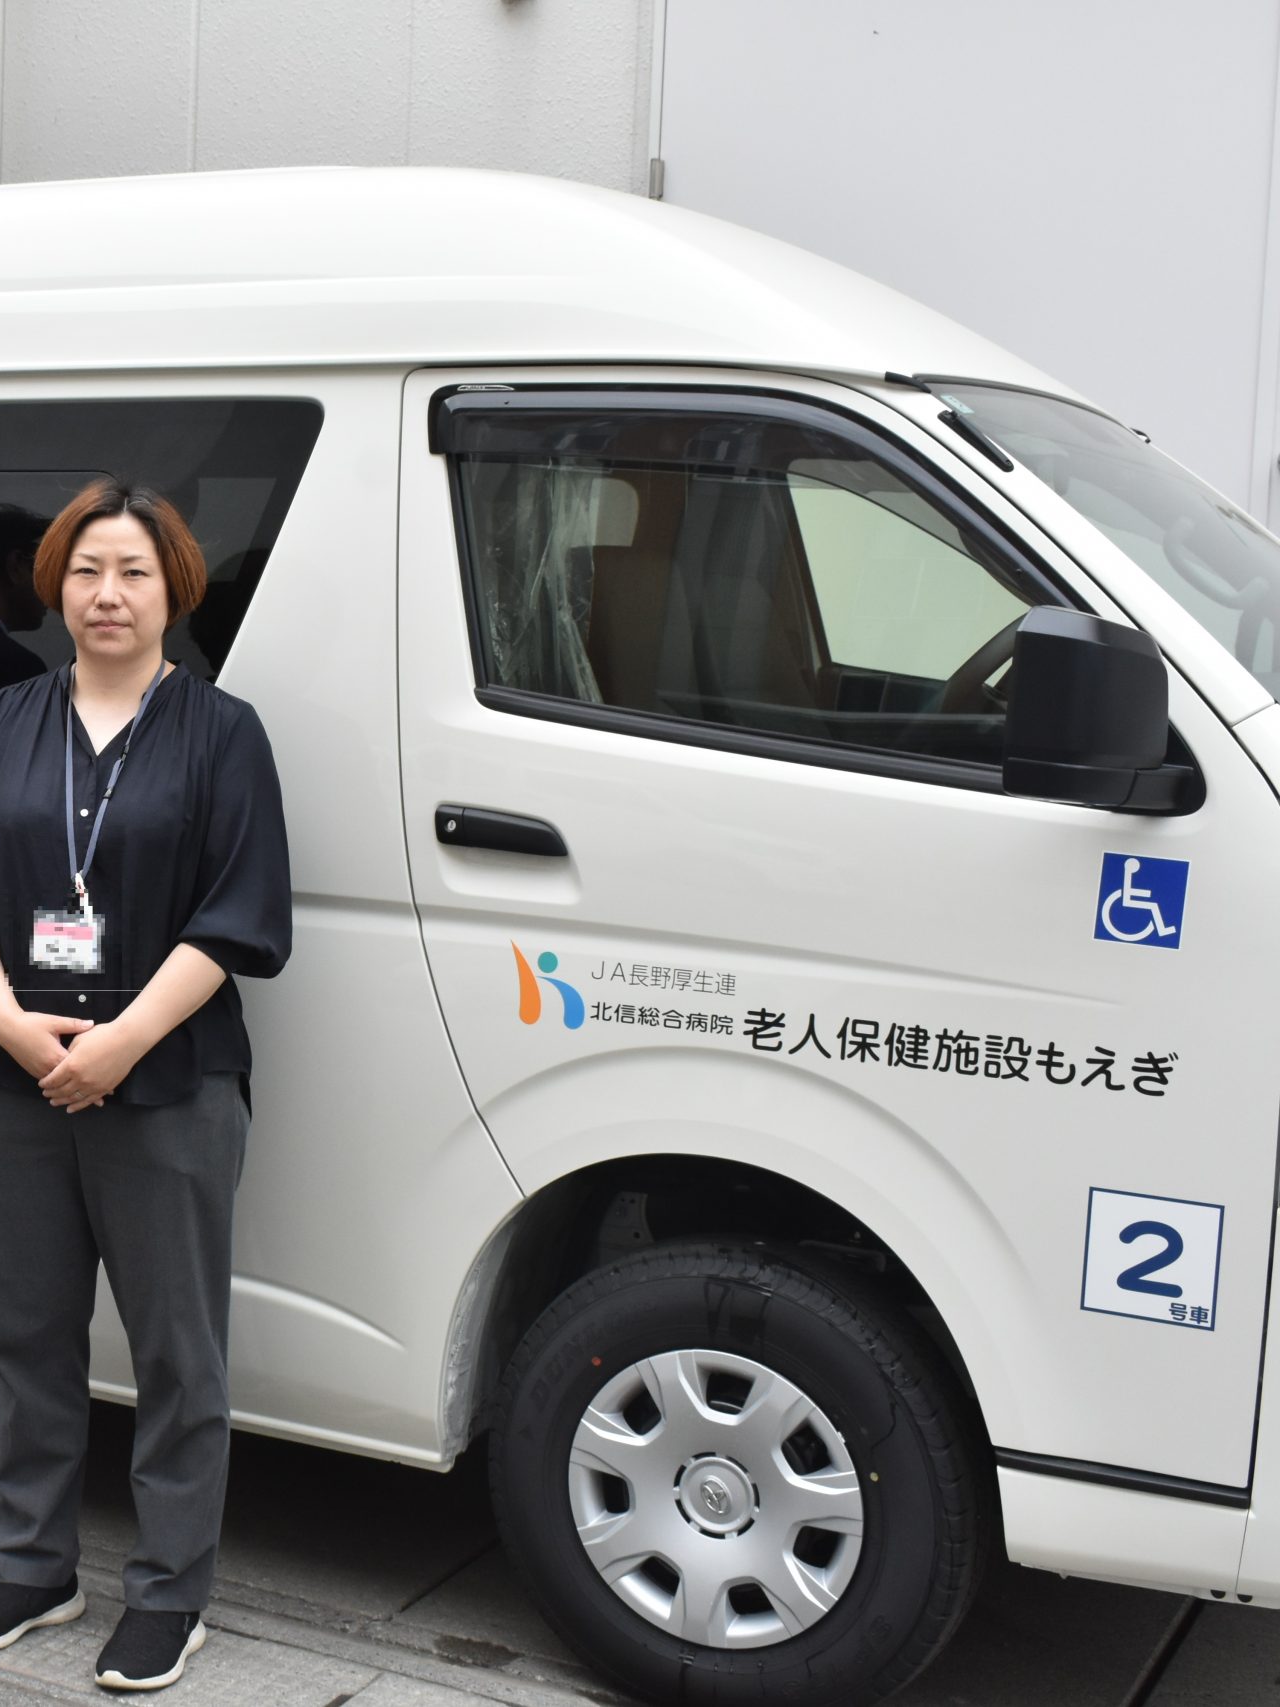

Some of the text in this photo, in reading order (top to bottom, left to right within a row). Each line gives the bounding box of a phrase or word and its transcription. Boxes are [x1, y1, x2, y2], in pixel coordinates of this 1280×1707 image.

[591, 961, 736, 996] JA長野厚生連
[590, 1002, 1179, 1097] 北信総合病院 老人保健施設もえぎ
[1117, 1221, 1209, 1325] 2 号車
